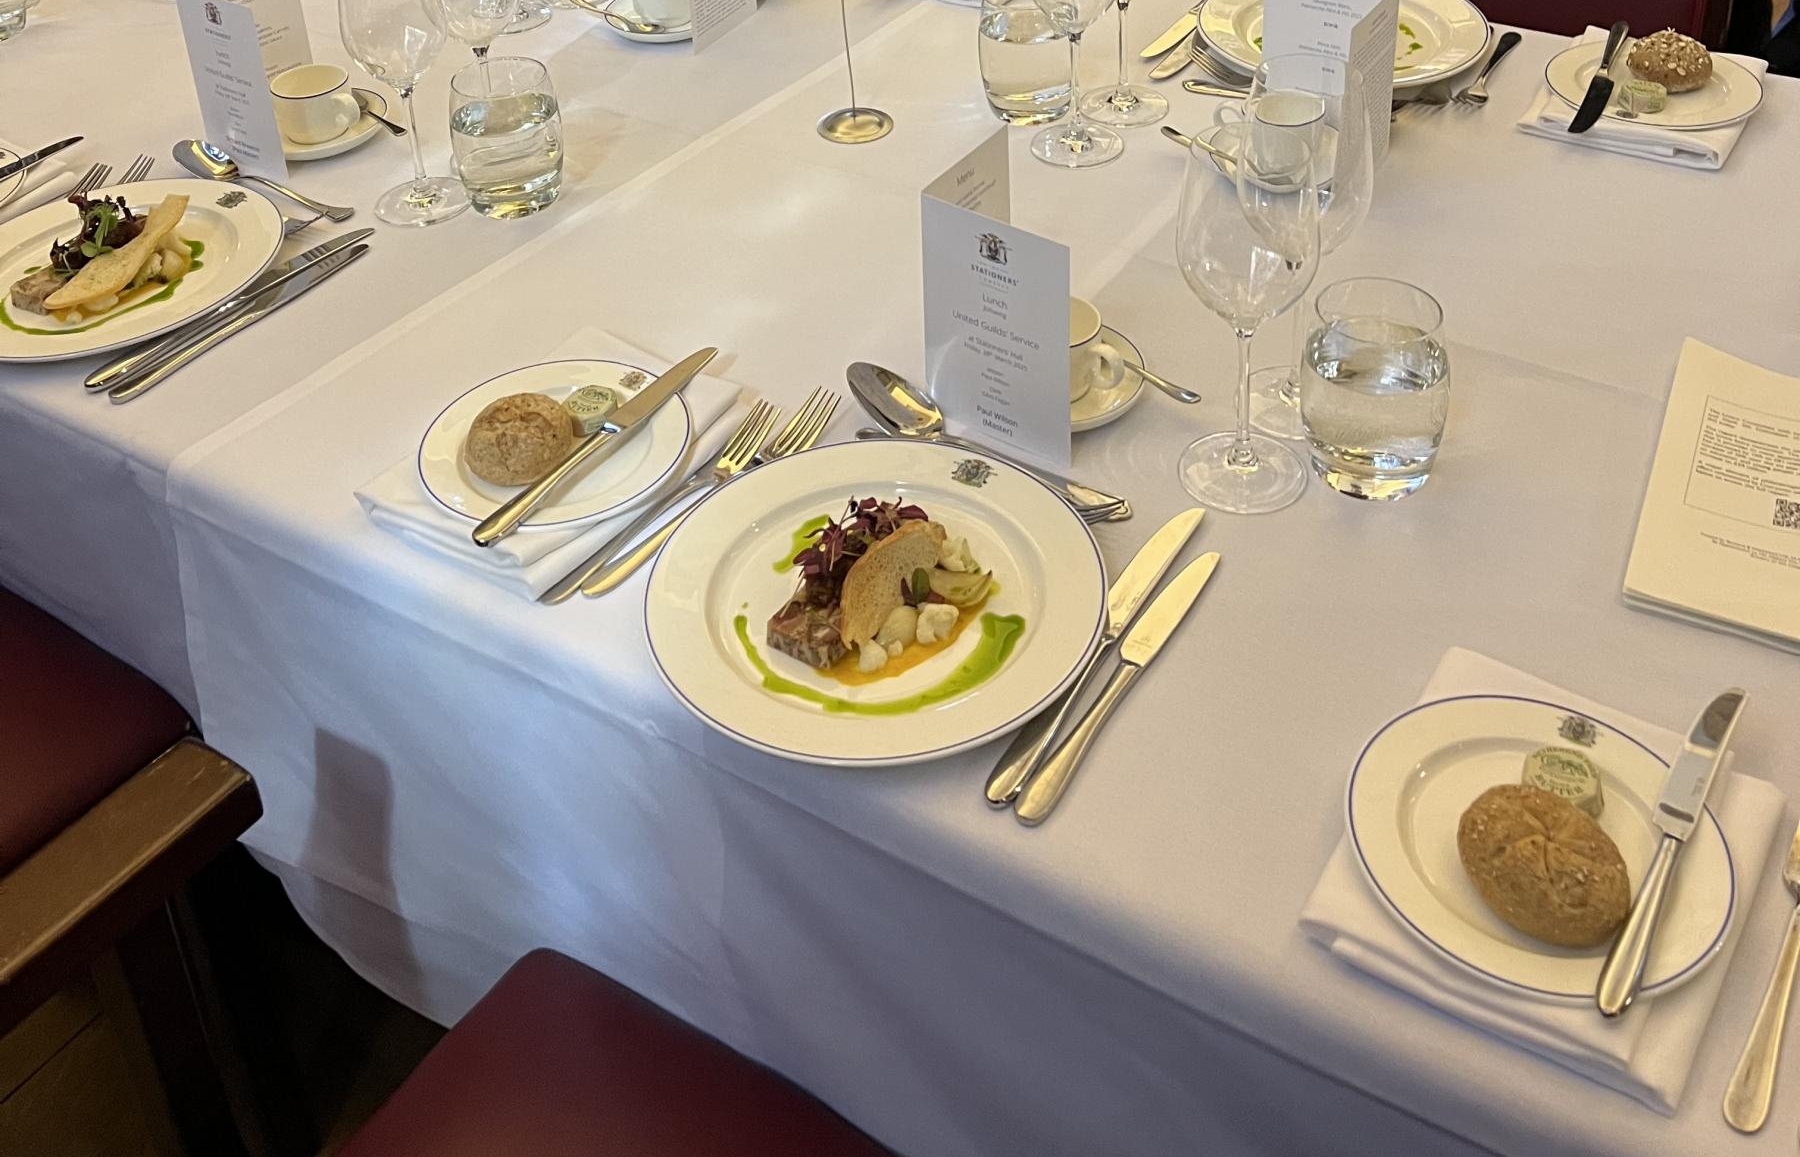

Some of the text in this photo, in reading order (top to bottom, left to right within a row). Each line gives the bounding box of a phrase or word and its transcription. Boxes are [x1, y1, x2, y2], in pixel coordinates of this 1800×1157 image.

[982, 292, 1008, 310] Lunch
[953, 309, 979, 327] United
[1010, 331, 1040, 350] Service
[976, 404, 1018, 428] Paul Wilson
[982, 418, 1013, 437] (Master)
[1535, 772, 1583, 797] BUTTER
